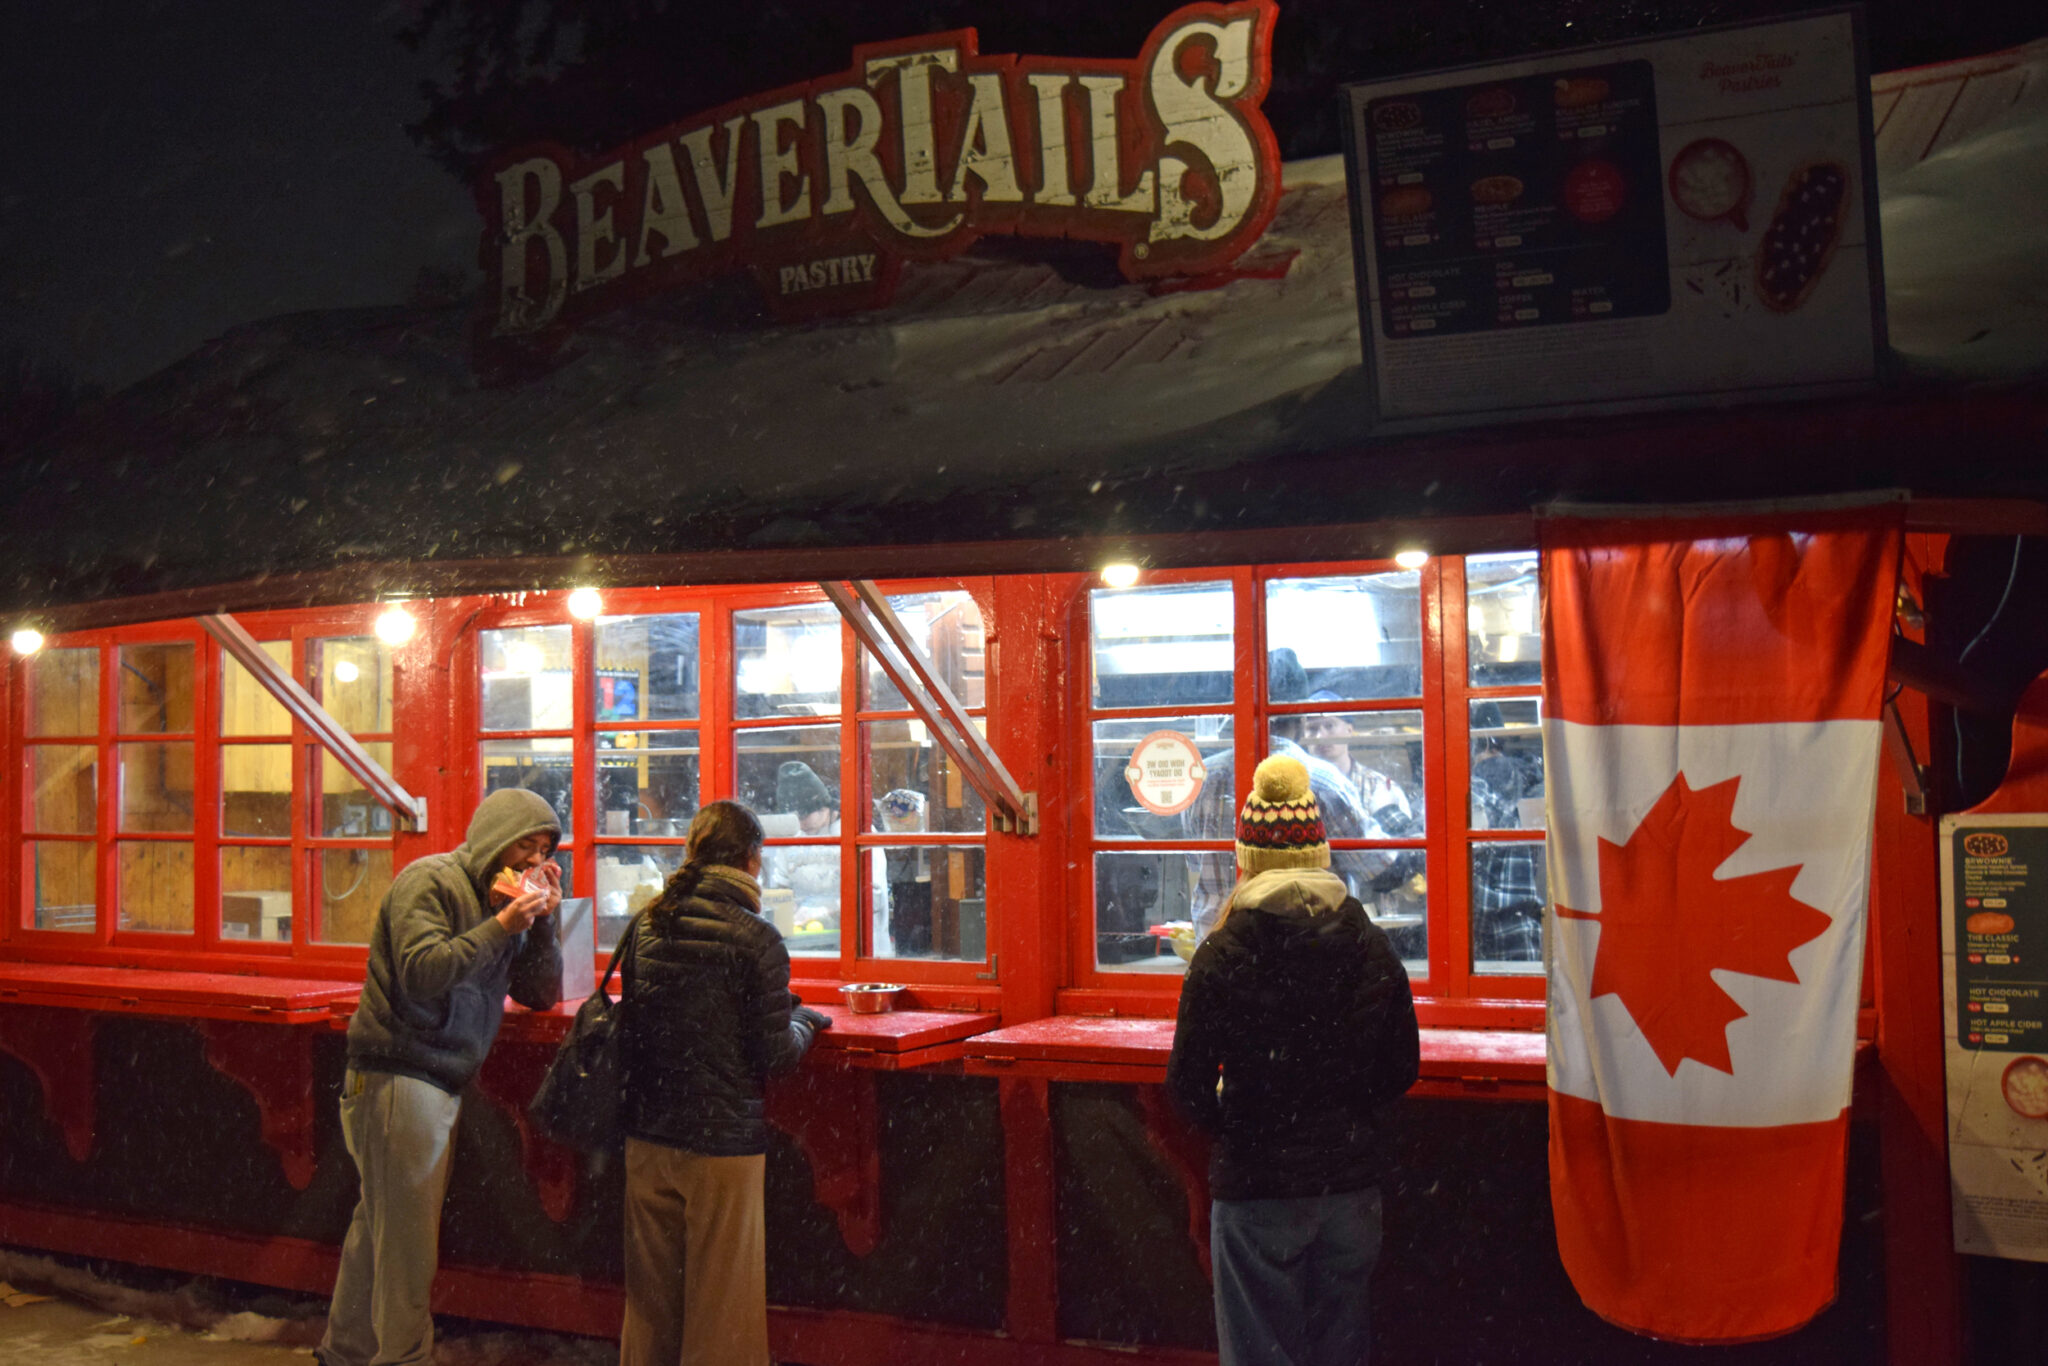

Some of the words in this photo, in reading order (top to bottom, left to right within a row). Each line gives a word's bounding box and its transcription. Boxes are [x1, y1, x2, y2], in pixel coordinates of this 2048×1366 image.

[492, 19, 1257, 338] BEAVERTAILS
[780, 254, 876, 295] PASTRY
[1967, 934, 1983, 942] THE
[1985, 934, 2019, 943] CLASSIC
[1988, 988, 2039, 998] CHOCOLATE
[1970, 1018, 1987, 1026] HOT
[1989, 1019, 2016, 1028] APPLE
[2017, 1020, 2043, 1029] CIDER
